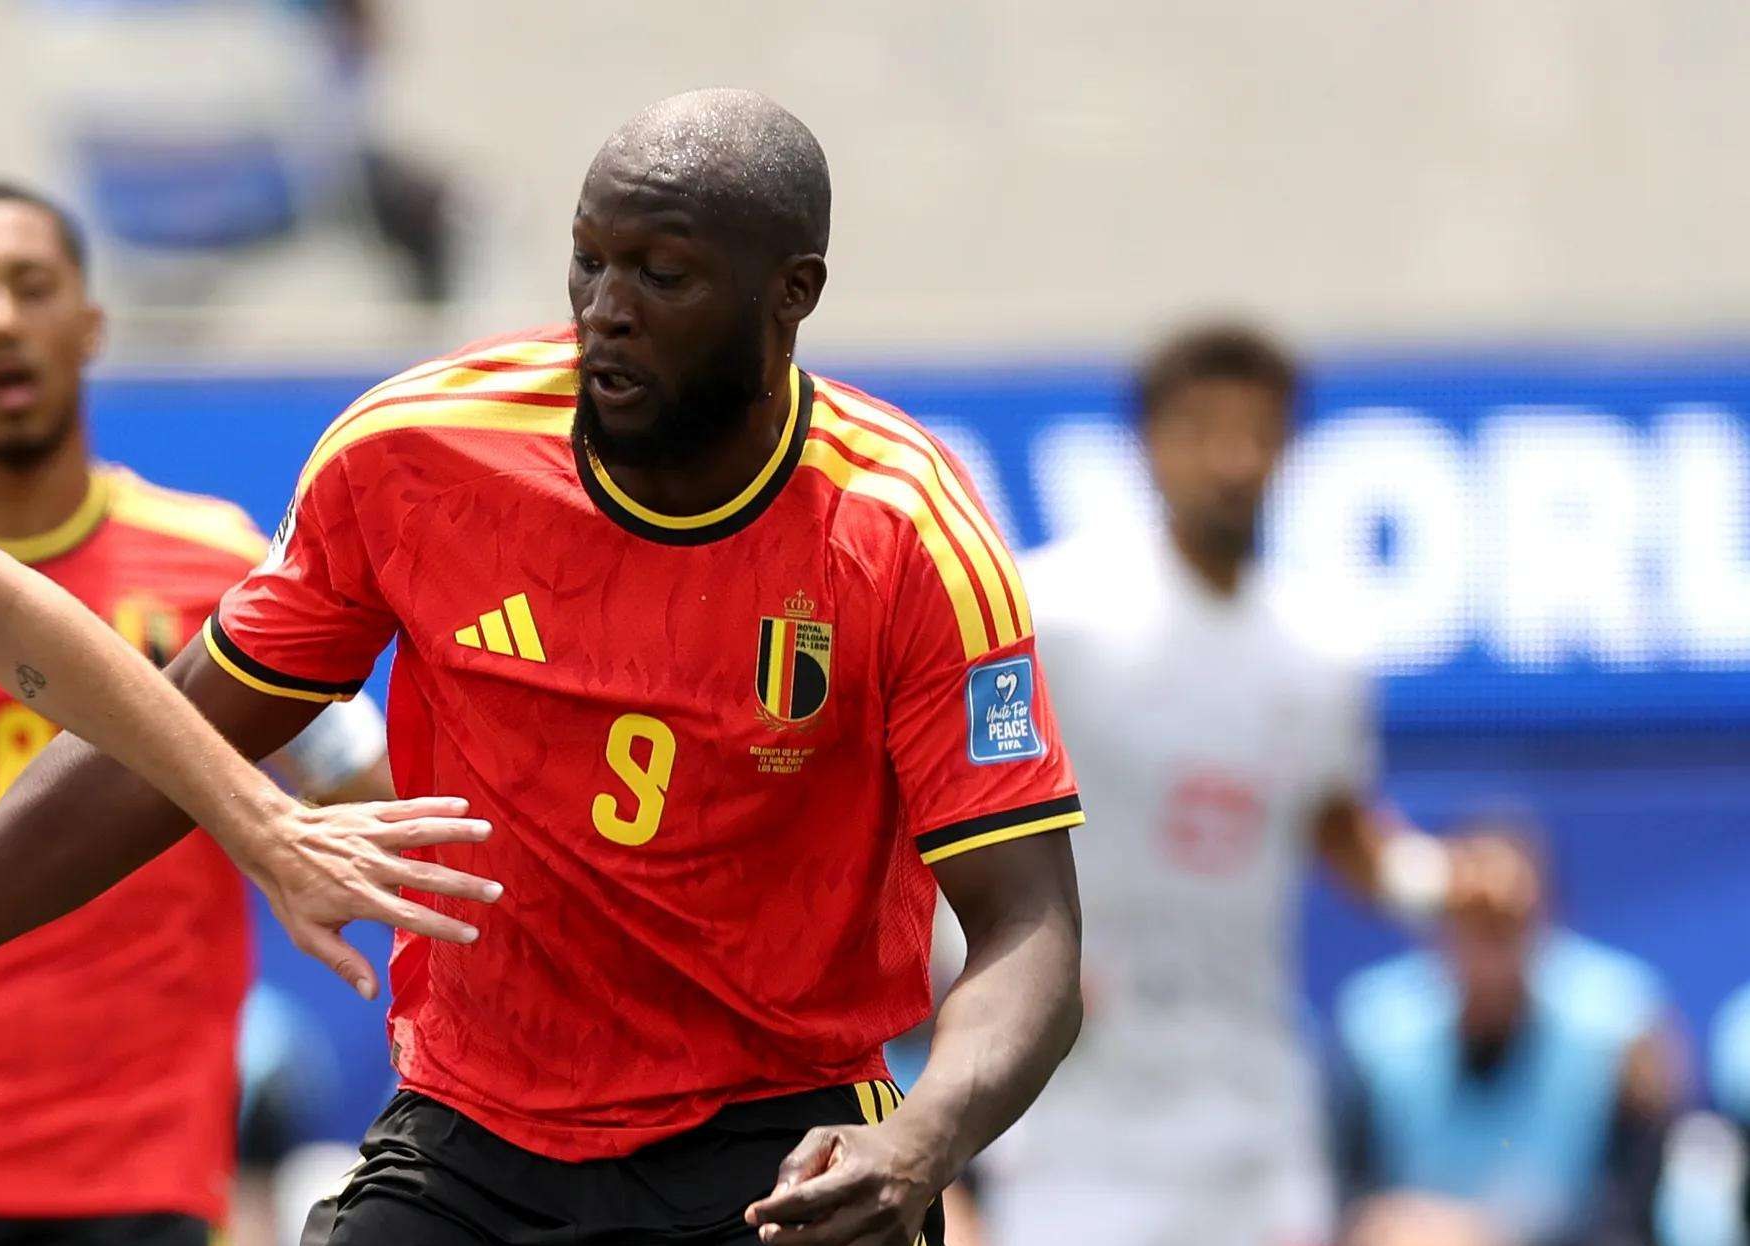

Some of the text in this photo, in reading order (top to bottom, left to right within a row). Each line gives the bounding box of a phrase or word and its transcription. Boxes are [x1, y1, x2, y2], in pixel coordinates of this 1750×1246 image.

[797, 623, 821, 634] ROYAL
[796, 632, 830, 643] BELGIAN
[987, 704, 1011, 723] Unite
[989, 719, 1028, 740] PEACE
[998, 740, 1021, 750] FIFA
[592, 713, 676, 846] 9
